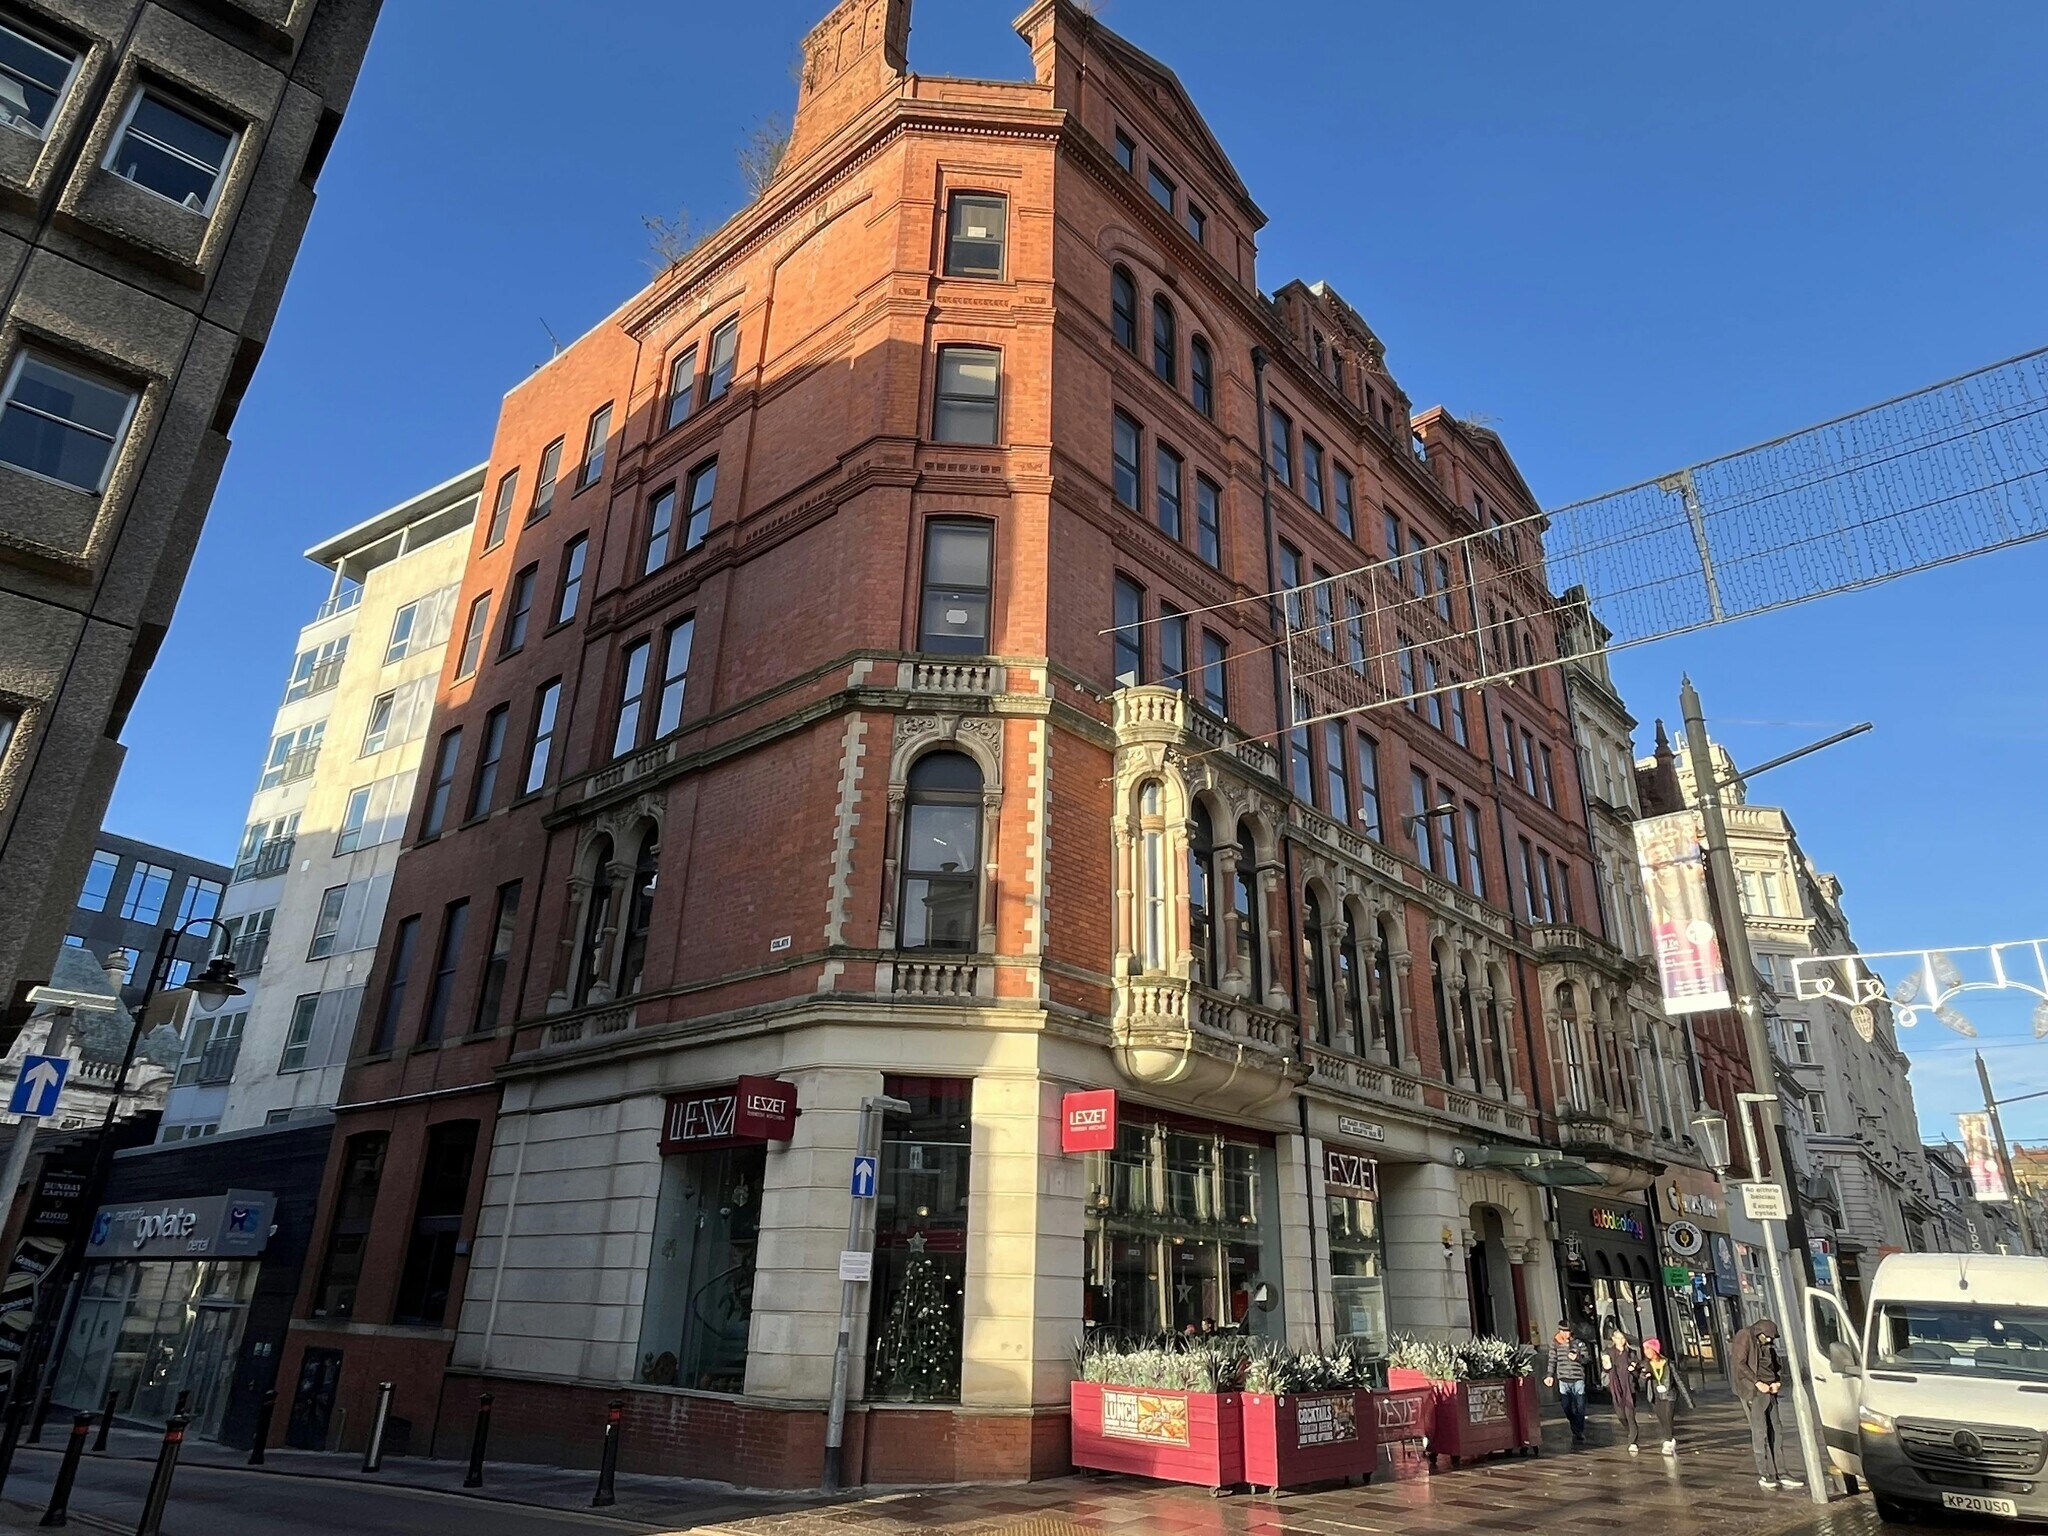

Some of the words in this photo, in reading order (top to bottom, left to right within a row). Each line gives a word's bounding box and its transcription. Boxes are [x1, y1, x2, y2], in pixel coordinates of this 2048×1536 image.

[747, 1094, 787, 1114] LESZET
[1070, 1108, 1107, 1125] LESZET
[40, 1211, 69, 1220] FOOD
[1105, 1401, 1138, 1422] LUNCH
[1299, 1405, 1332, 1424] COCKTAILS
[1377, 1397, 1423, 1428] LESZET
[1947, 1495, 1982, 1510] KP20
